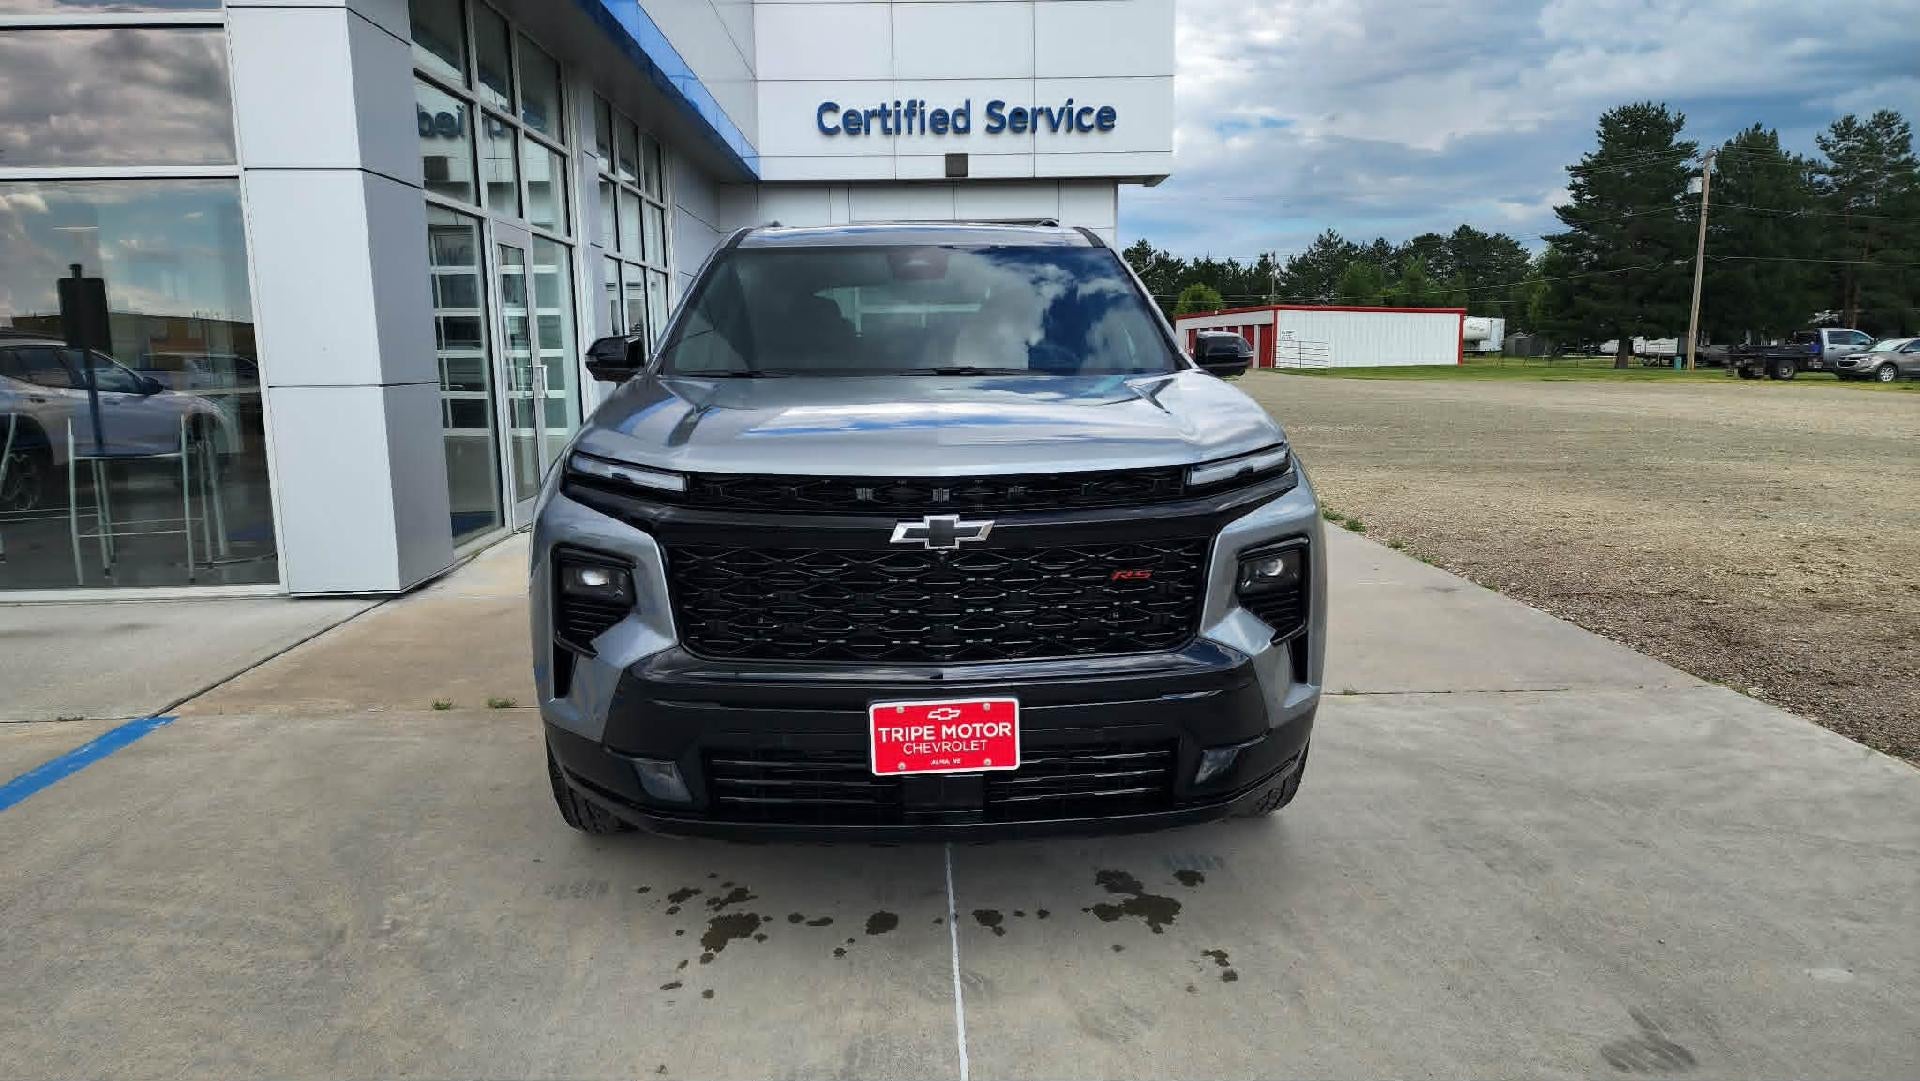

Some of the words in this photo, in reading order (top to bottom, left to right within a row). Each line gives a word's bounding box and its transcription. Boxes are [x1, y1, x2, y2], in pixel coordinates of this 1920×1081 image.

[817, 99, 970, 136] Certified
[985, 98, 1117, 134] Service
[1111, 570, 1152, 580] RS
[878, 725, 936, 743] TRIPE
[941, 722, 1012, 739] MOTOR
[903, 739, 988, 755] CHEVROLET
